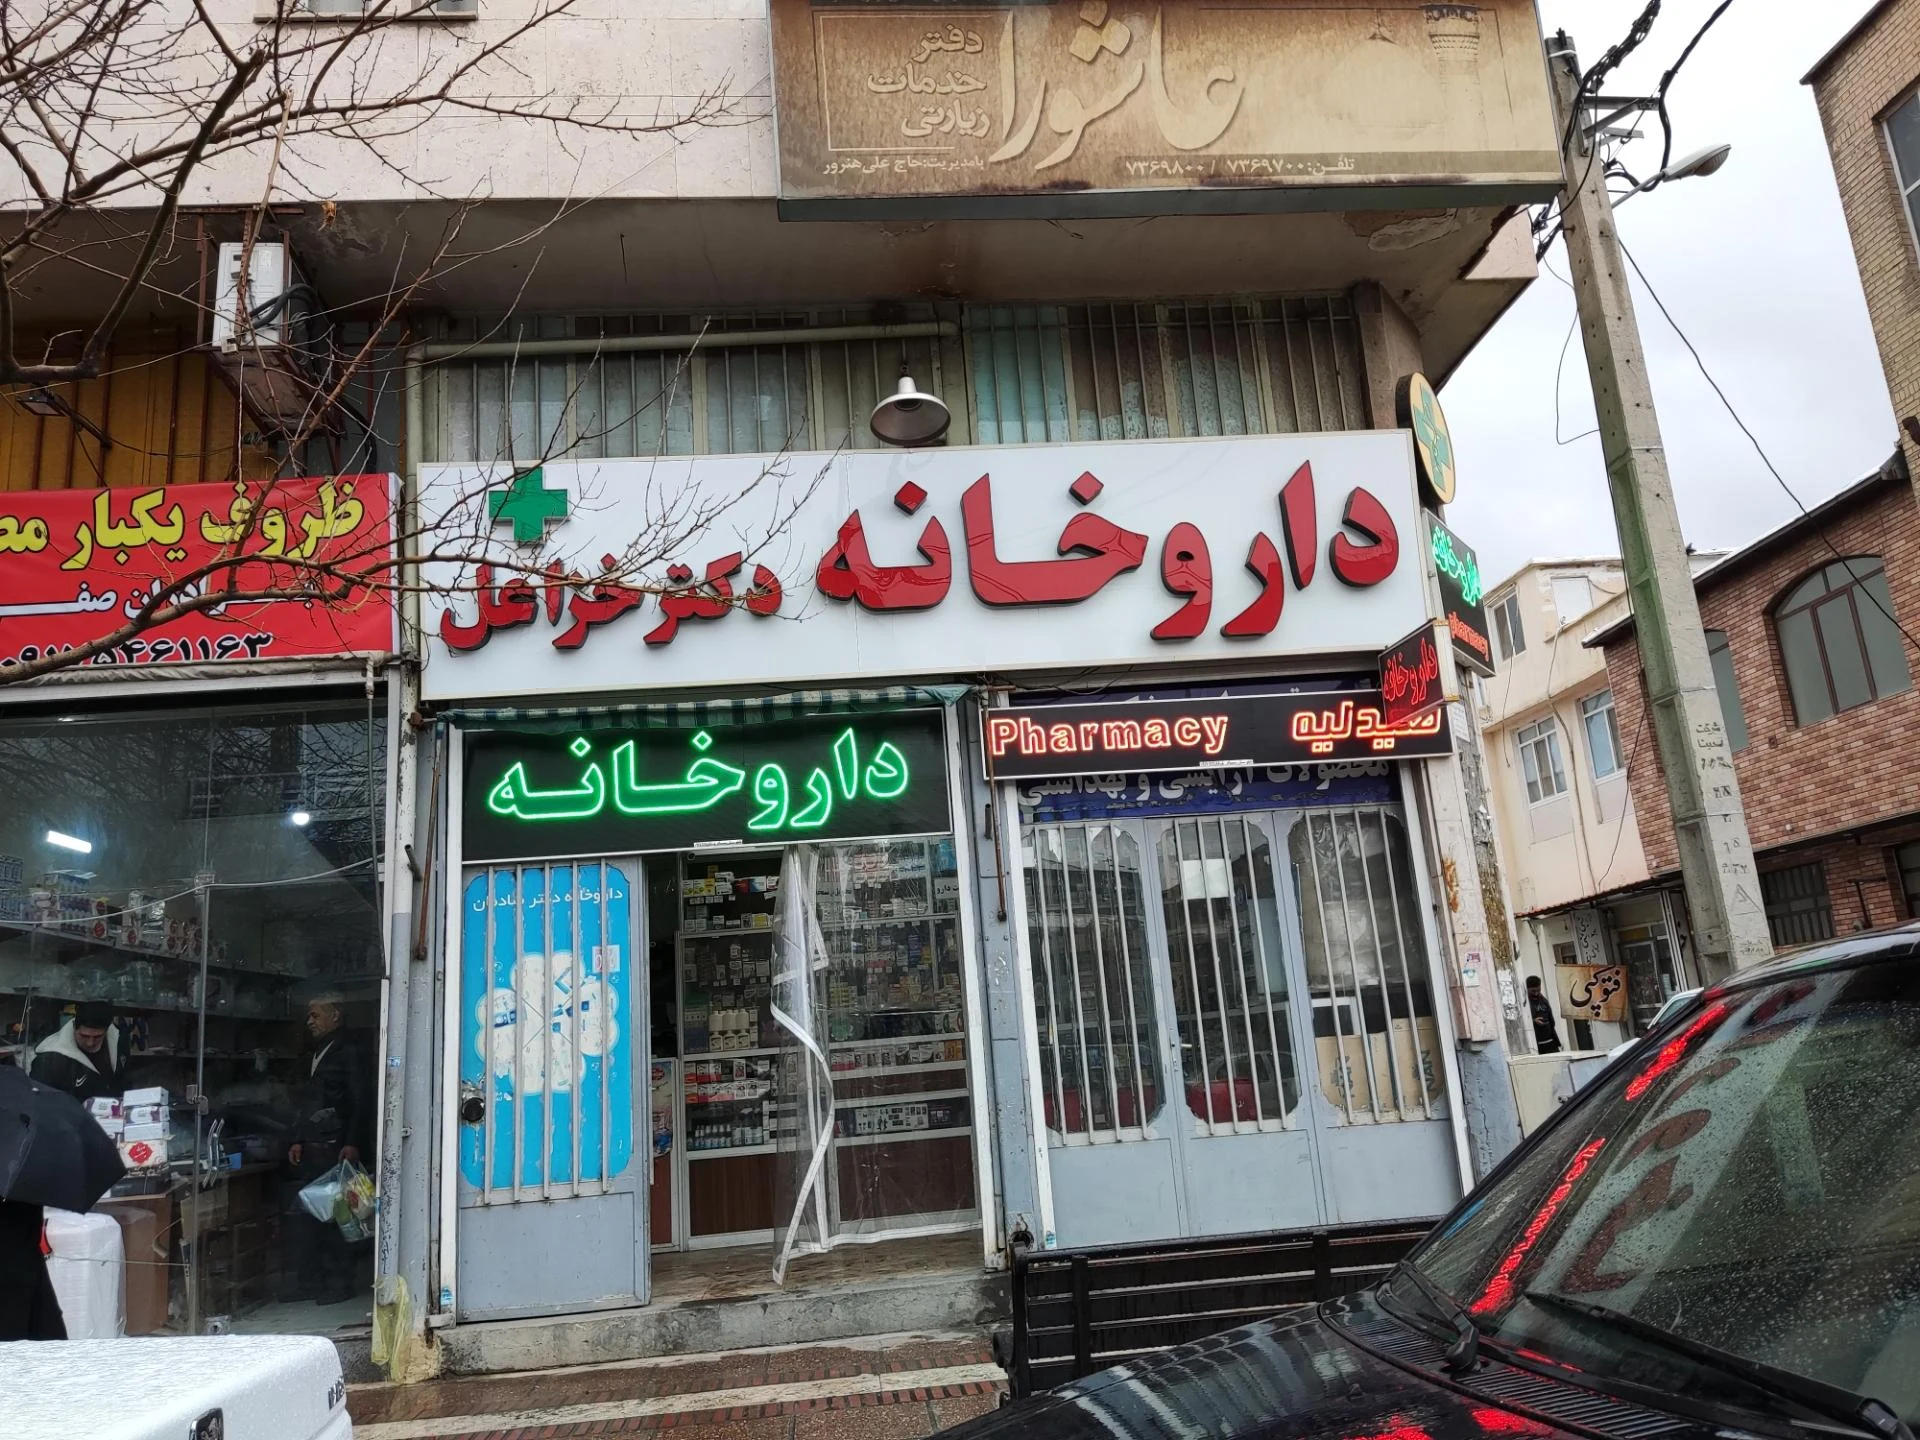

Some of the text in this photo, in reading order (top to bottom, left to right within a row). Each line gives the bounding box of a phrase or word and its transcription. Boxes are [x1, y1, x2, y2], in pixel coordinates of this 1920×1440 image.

[911, 24, 985, 63] دفتر
[867, 61, 988, 95] خدمات
[901, 99, 991, 139] زیارتی
[61, 488, 185, 572] یکبار
[199, 481, 365, 558] ظروف
[815, 459, 1400, 641] داروخانه
[643, 551, 783, 646] دکتر
[990, 716, 1229, 756] Pharmacy
[488, 727, 910, 831] داروخانه
[1569, 964, 1622, 1018] فتوکپی
